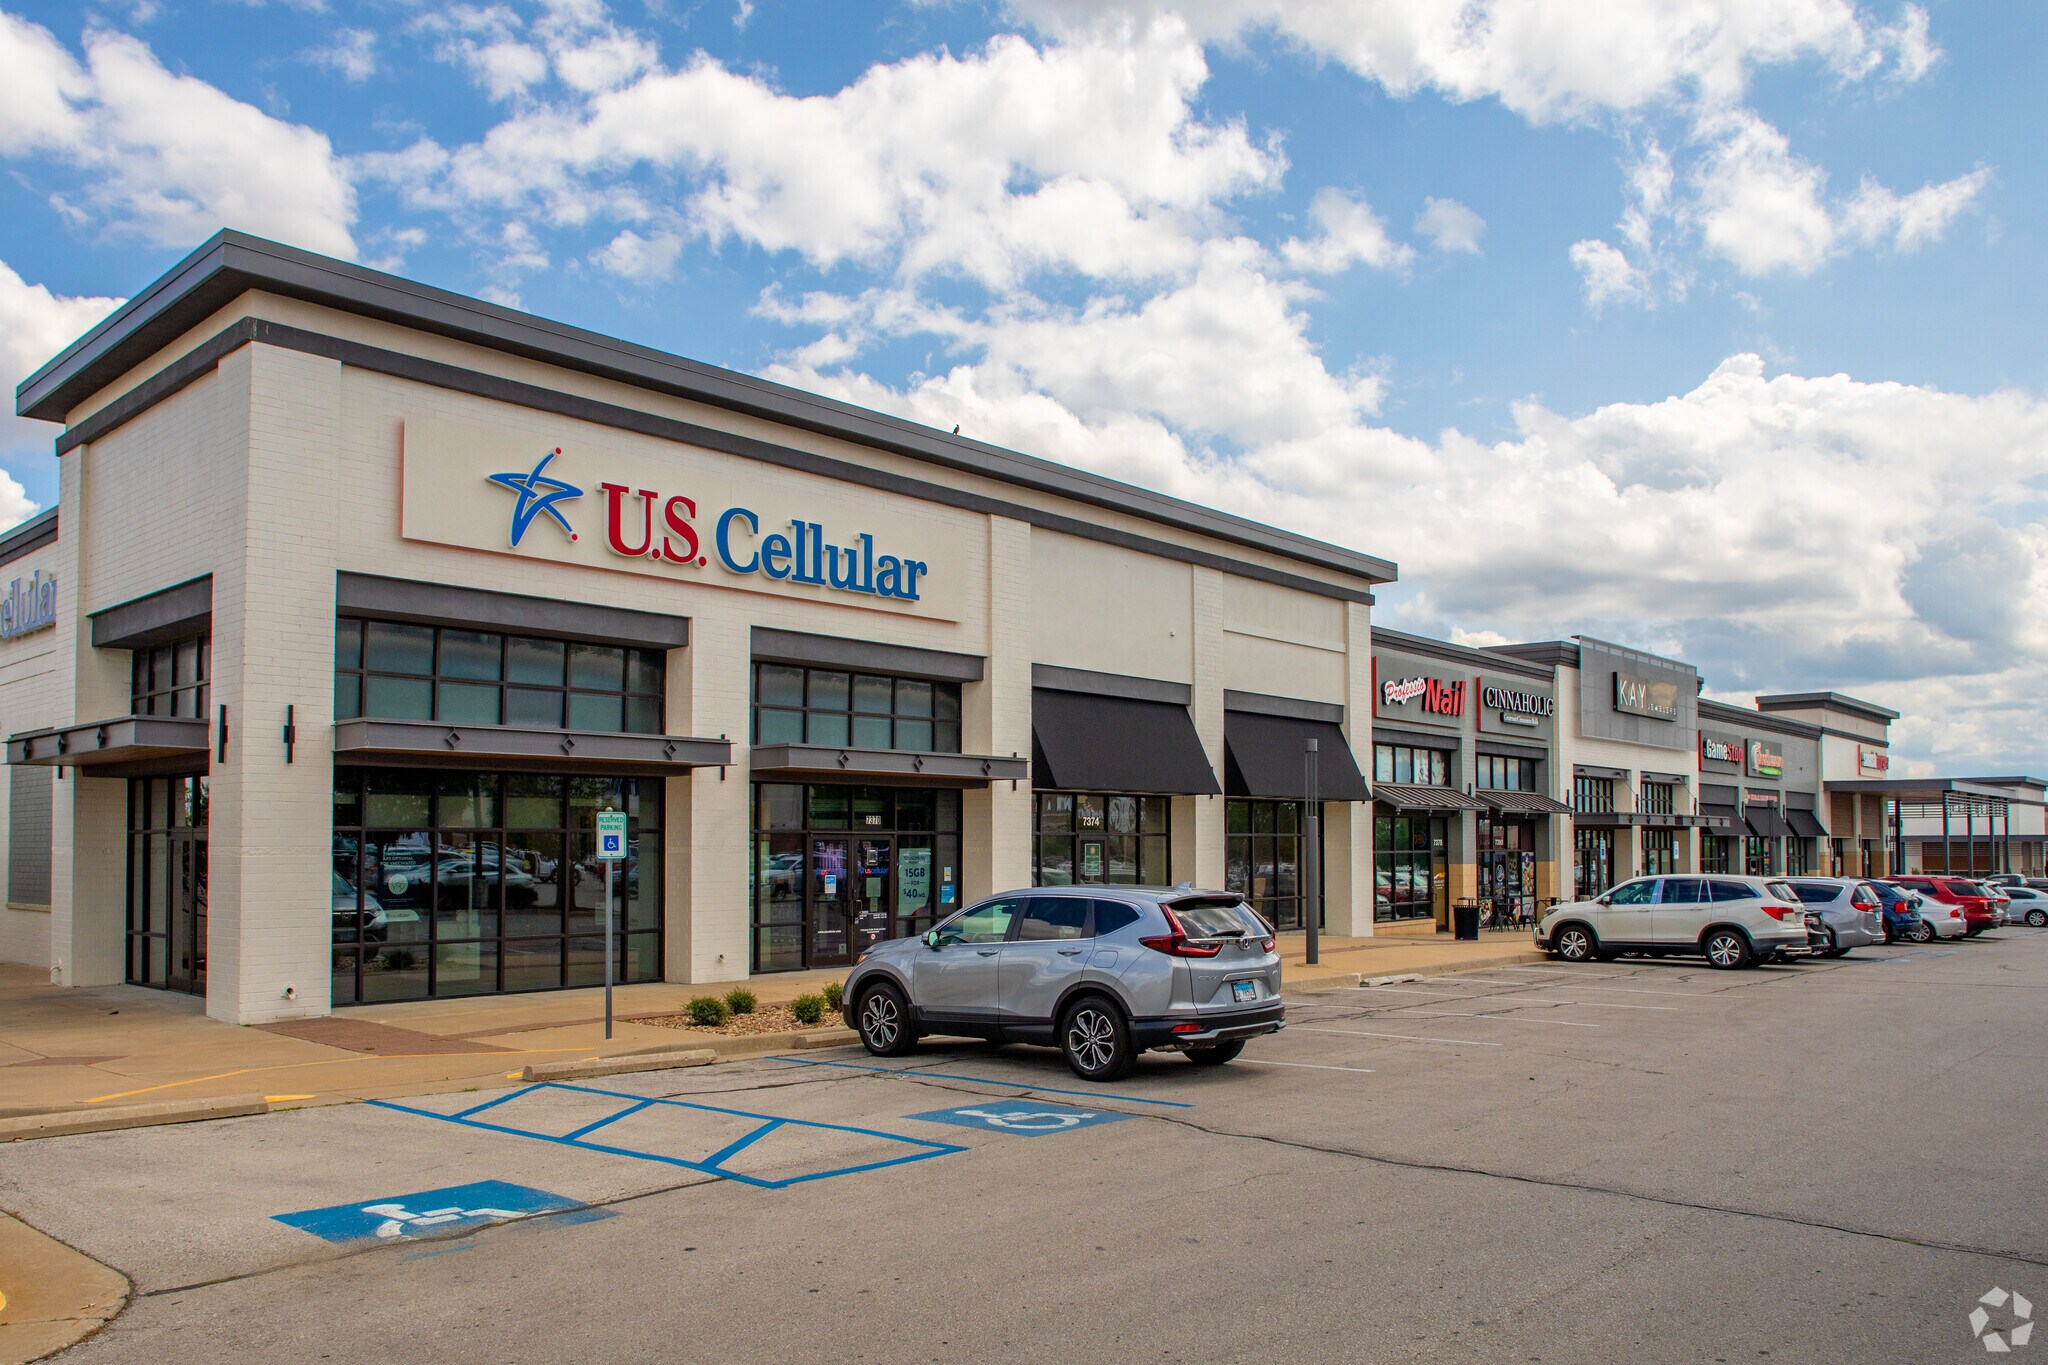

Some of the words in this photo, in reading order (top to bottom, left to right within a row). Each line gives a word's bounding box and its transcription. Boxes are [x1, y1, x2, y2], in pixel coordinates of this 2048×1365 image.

[598, 482, 707, 567] U.S.
[715, 507, 927, 602] Cellular
[1384, 677, 1426, 705] Professio
[1424, 677, 1466, 717] Nail
[1486, 687, 1553, 717] CINNAHOLIC
[1619, 680, 1647, 709] KAY
[1705, 738, 1744, 764] GameStop
[865, 815, 881, 825] 7370
[1082, 816, 1100, 826] 7374
[904, 868, 925, 878] 15GB
